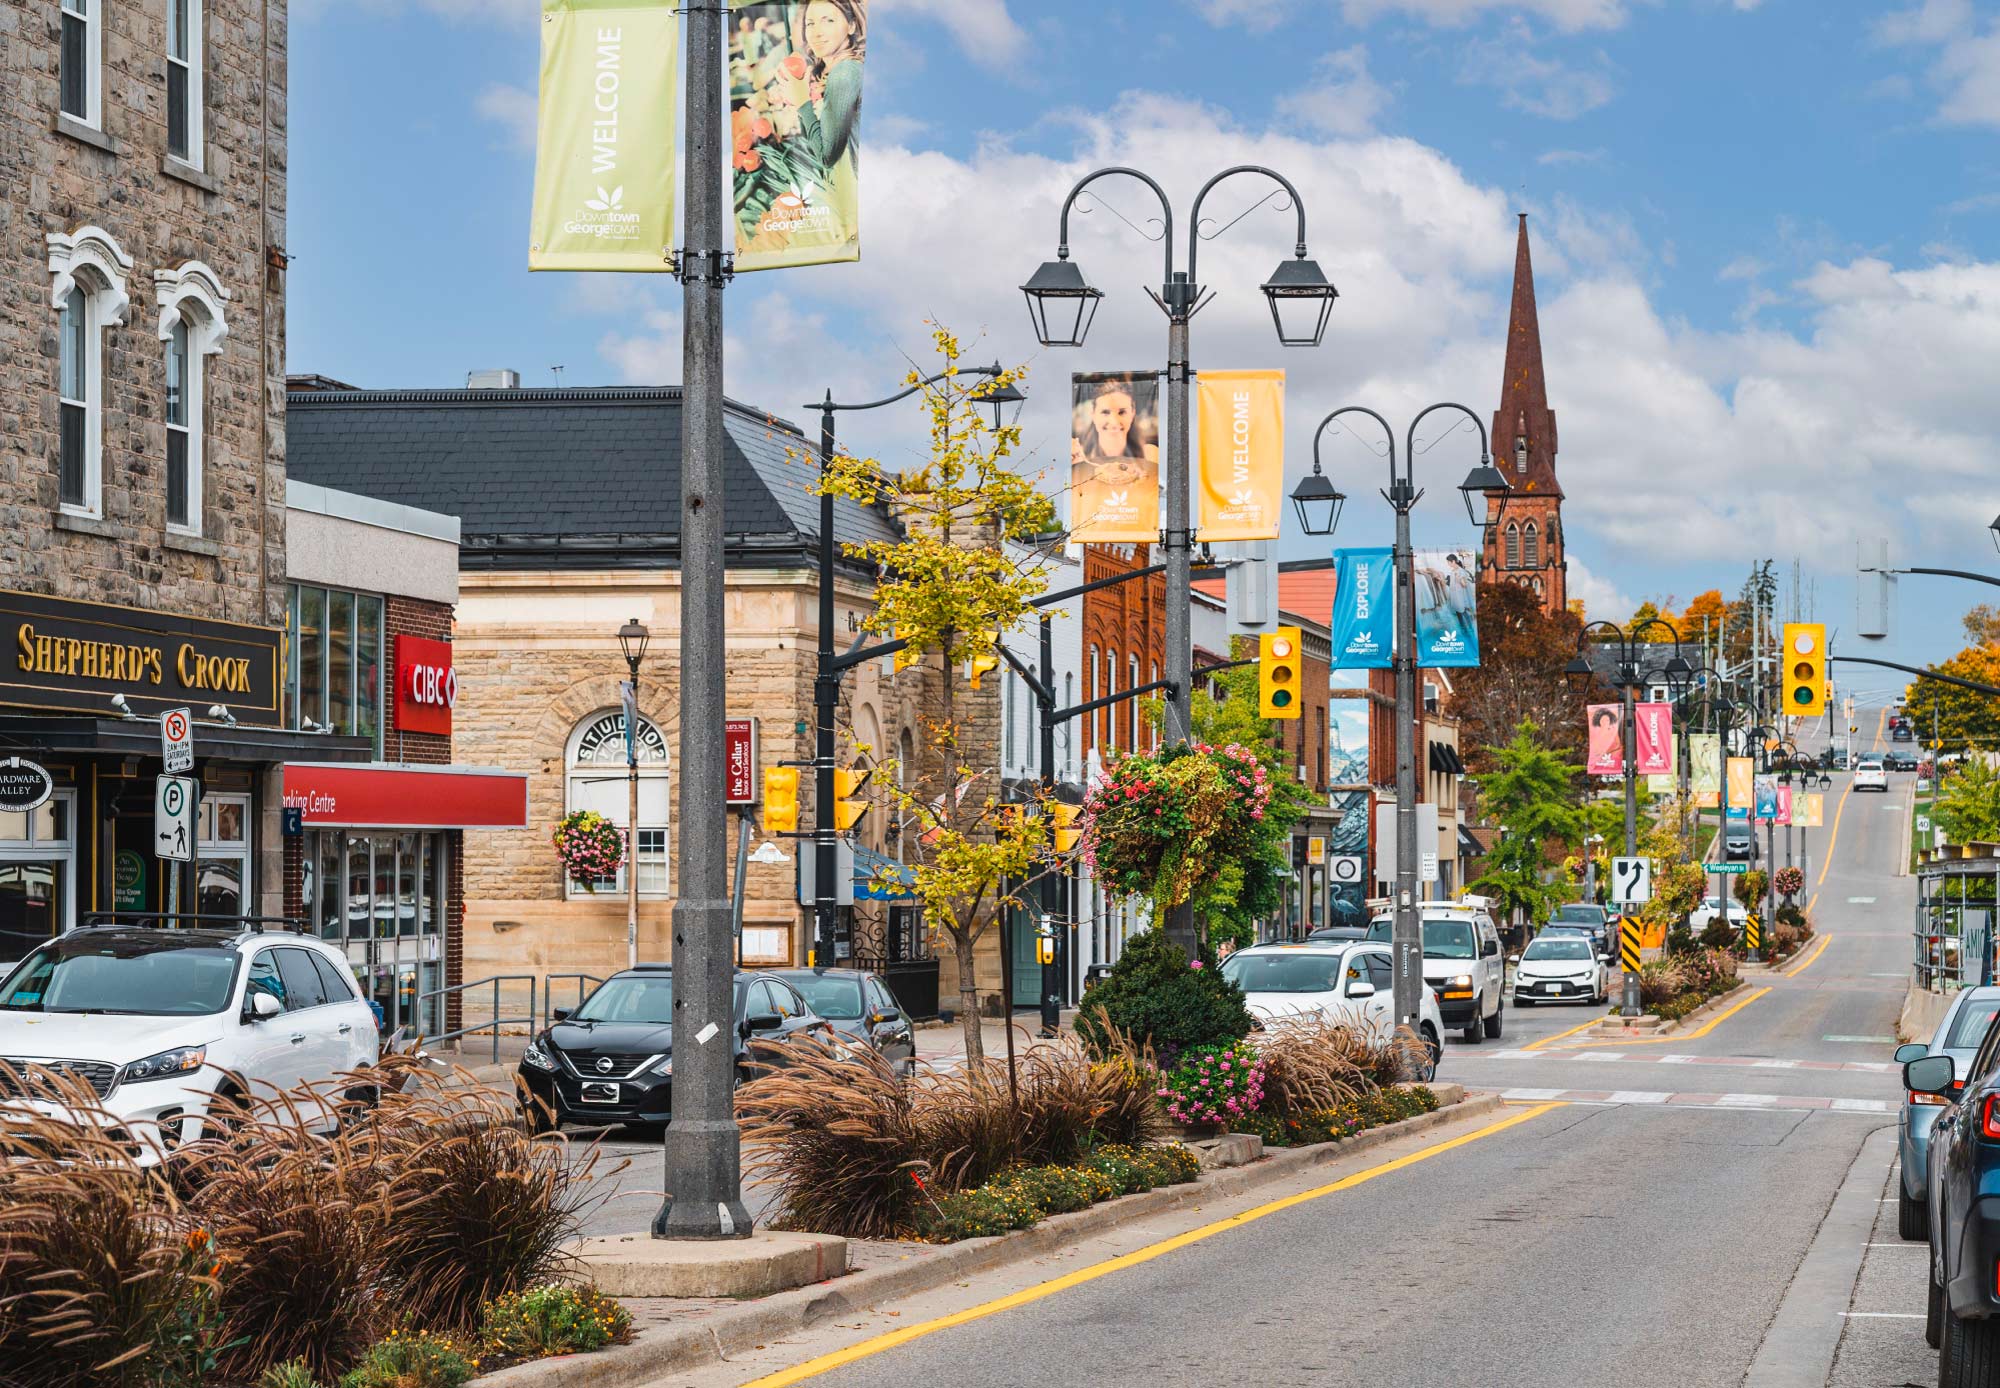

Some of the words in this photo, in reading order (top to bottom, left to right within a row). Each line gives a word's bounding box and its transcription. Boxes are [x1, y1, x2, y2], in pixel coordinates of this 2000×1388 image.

[592, 27, 621, 174] WELCOME
[575, 209, 640, 222] Downtown
[771, 206, 830, 219] Downtown
[564, 220, 640, 237] Georgetown
[763, 216, 830, 232] Georgetown
[1233, 392, 1249, 484] WELCOME
[1357, 562, 1369, 619] EXPLORE
[18, 623, 162, 685] SHEPHERD'S
[177, 643, 251, 693] CROOK
[413, 664, 444, 705] CIBC
[1650, 711, 1658, 747] EXPLORE
[167, 749, 190, 760] SATURDAYS
[731, 741, 742, 776] Cellar
[0, 775, 41, 783] ARDWARE
[731, 778, 742, 796] the
[0, 786, 31, 794] ALLEY
[283, 789, 308, 817] anking
[310, 790, 336, 813] Centre
[1918, 821, 1929, 829] 40
[1709, 863, 1738, 873] Wesleyan
